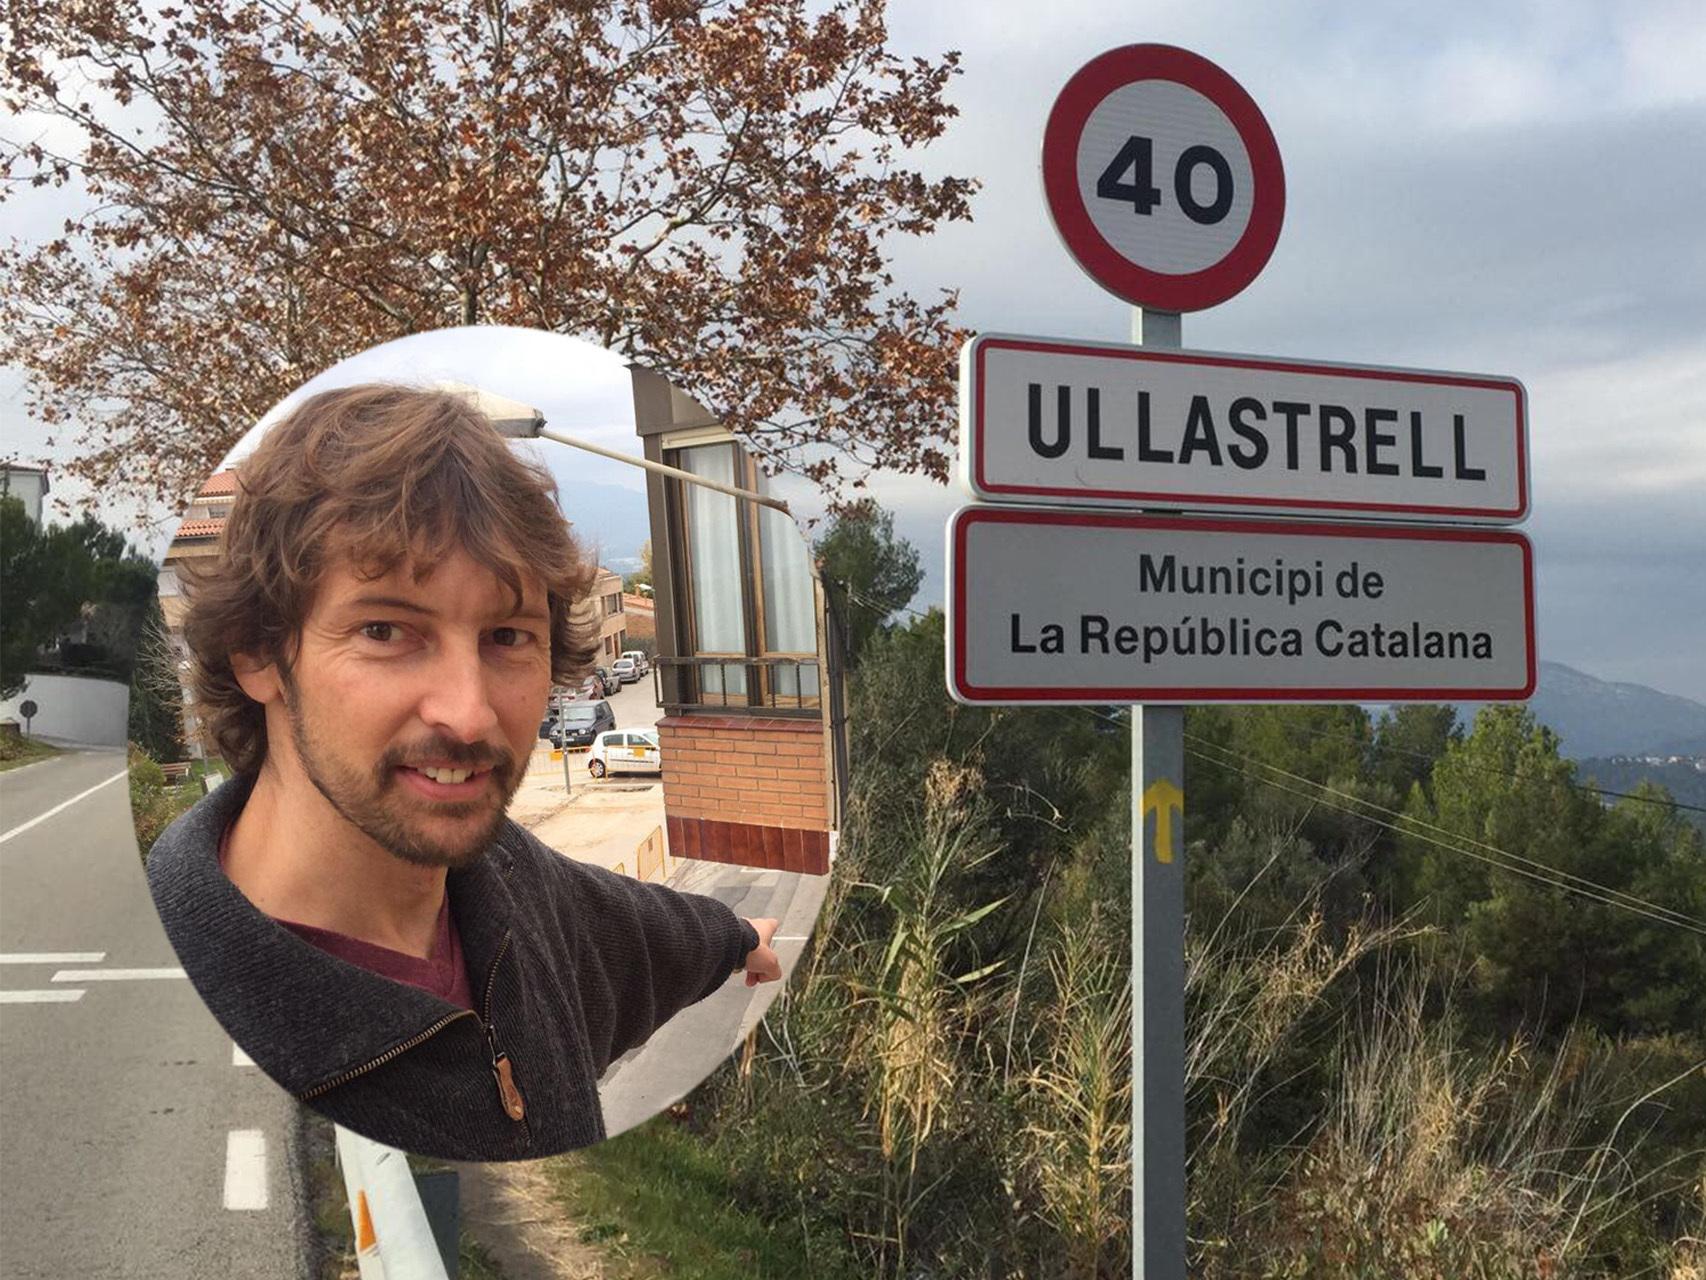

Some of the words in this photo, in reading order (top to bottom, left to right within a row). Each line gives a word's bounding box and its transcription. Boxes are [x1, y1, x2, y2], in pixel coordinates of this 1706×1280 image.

[1096, 135, 1234, 225] 40
[1027, 383, 1487, 482] ULLASTRELL
[1138, 553, 1324, 605] Municipi
[1334, 561, 1386, 600] de
[1010, 613, 1065, 655] La
[1079, 613, 1304, 663] República
[1314, 618, 1494, 660] Catalana
